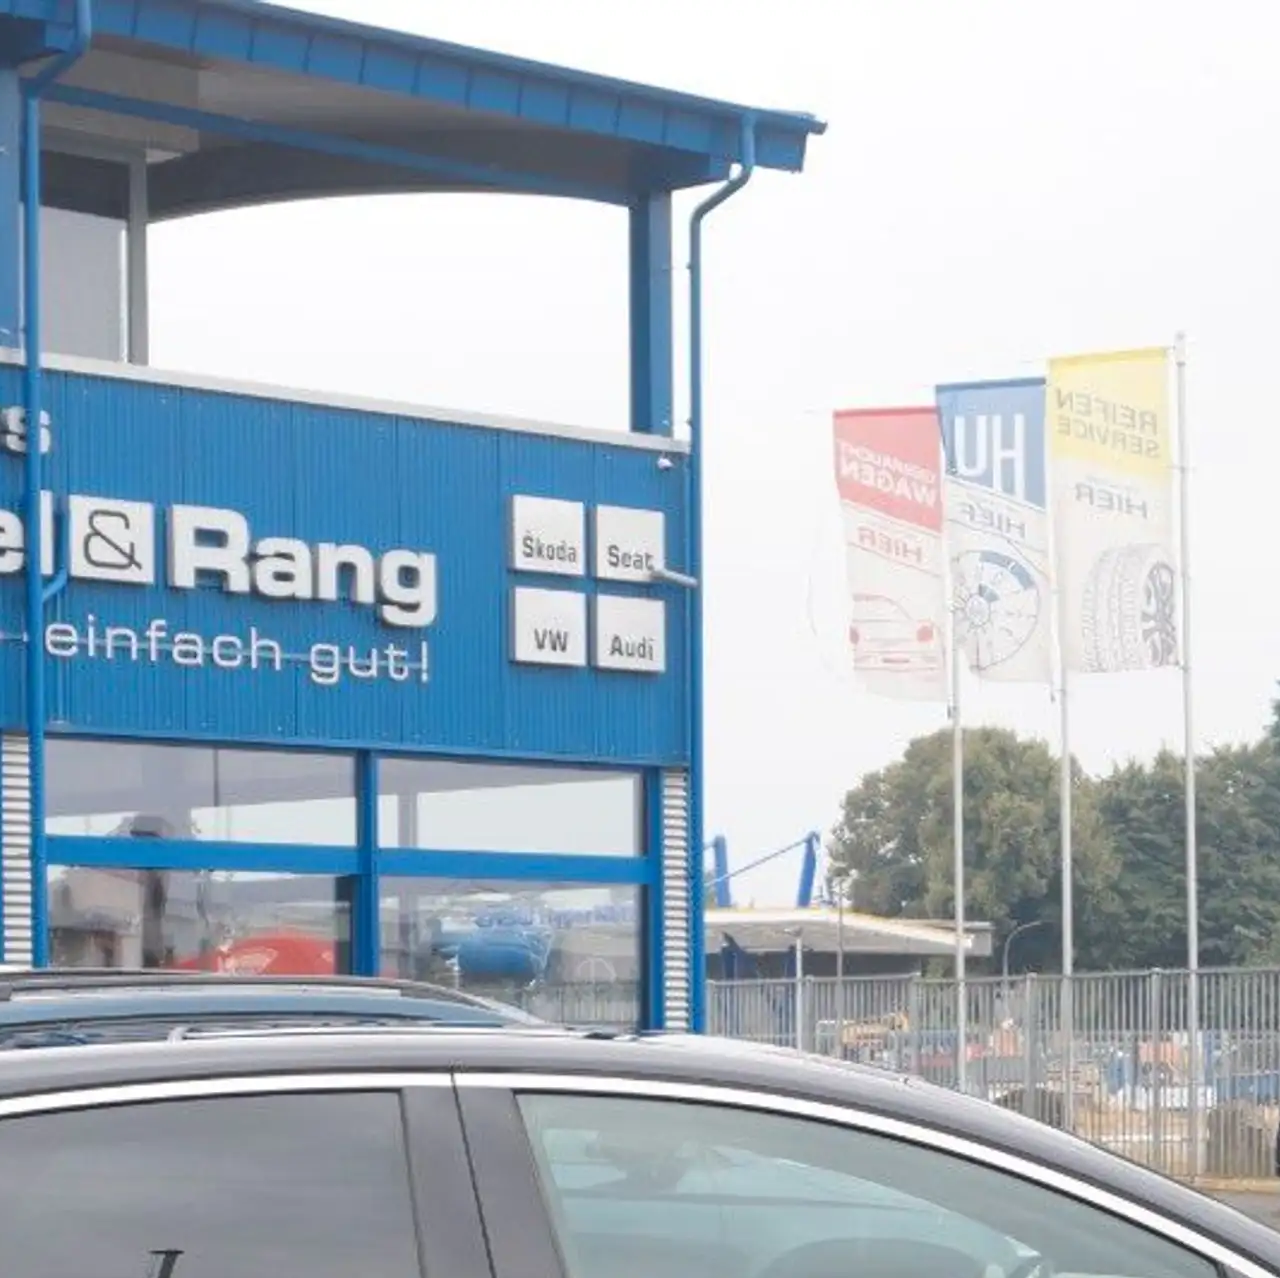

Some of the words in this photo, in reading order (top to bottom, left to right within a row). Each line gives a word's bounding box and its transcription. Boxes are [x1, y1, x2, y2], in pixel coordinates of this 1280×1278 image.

[522, 529, 578, 563] Škoda
[606, 543, 657, 571] Seat
[168, 503, 437, 627] Rang
[533, 627, 570, 653] VW
[609, 633, 654, 661] Audi
[309, 641, 429, 685] gut!
